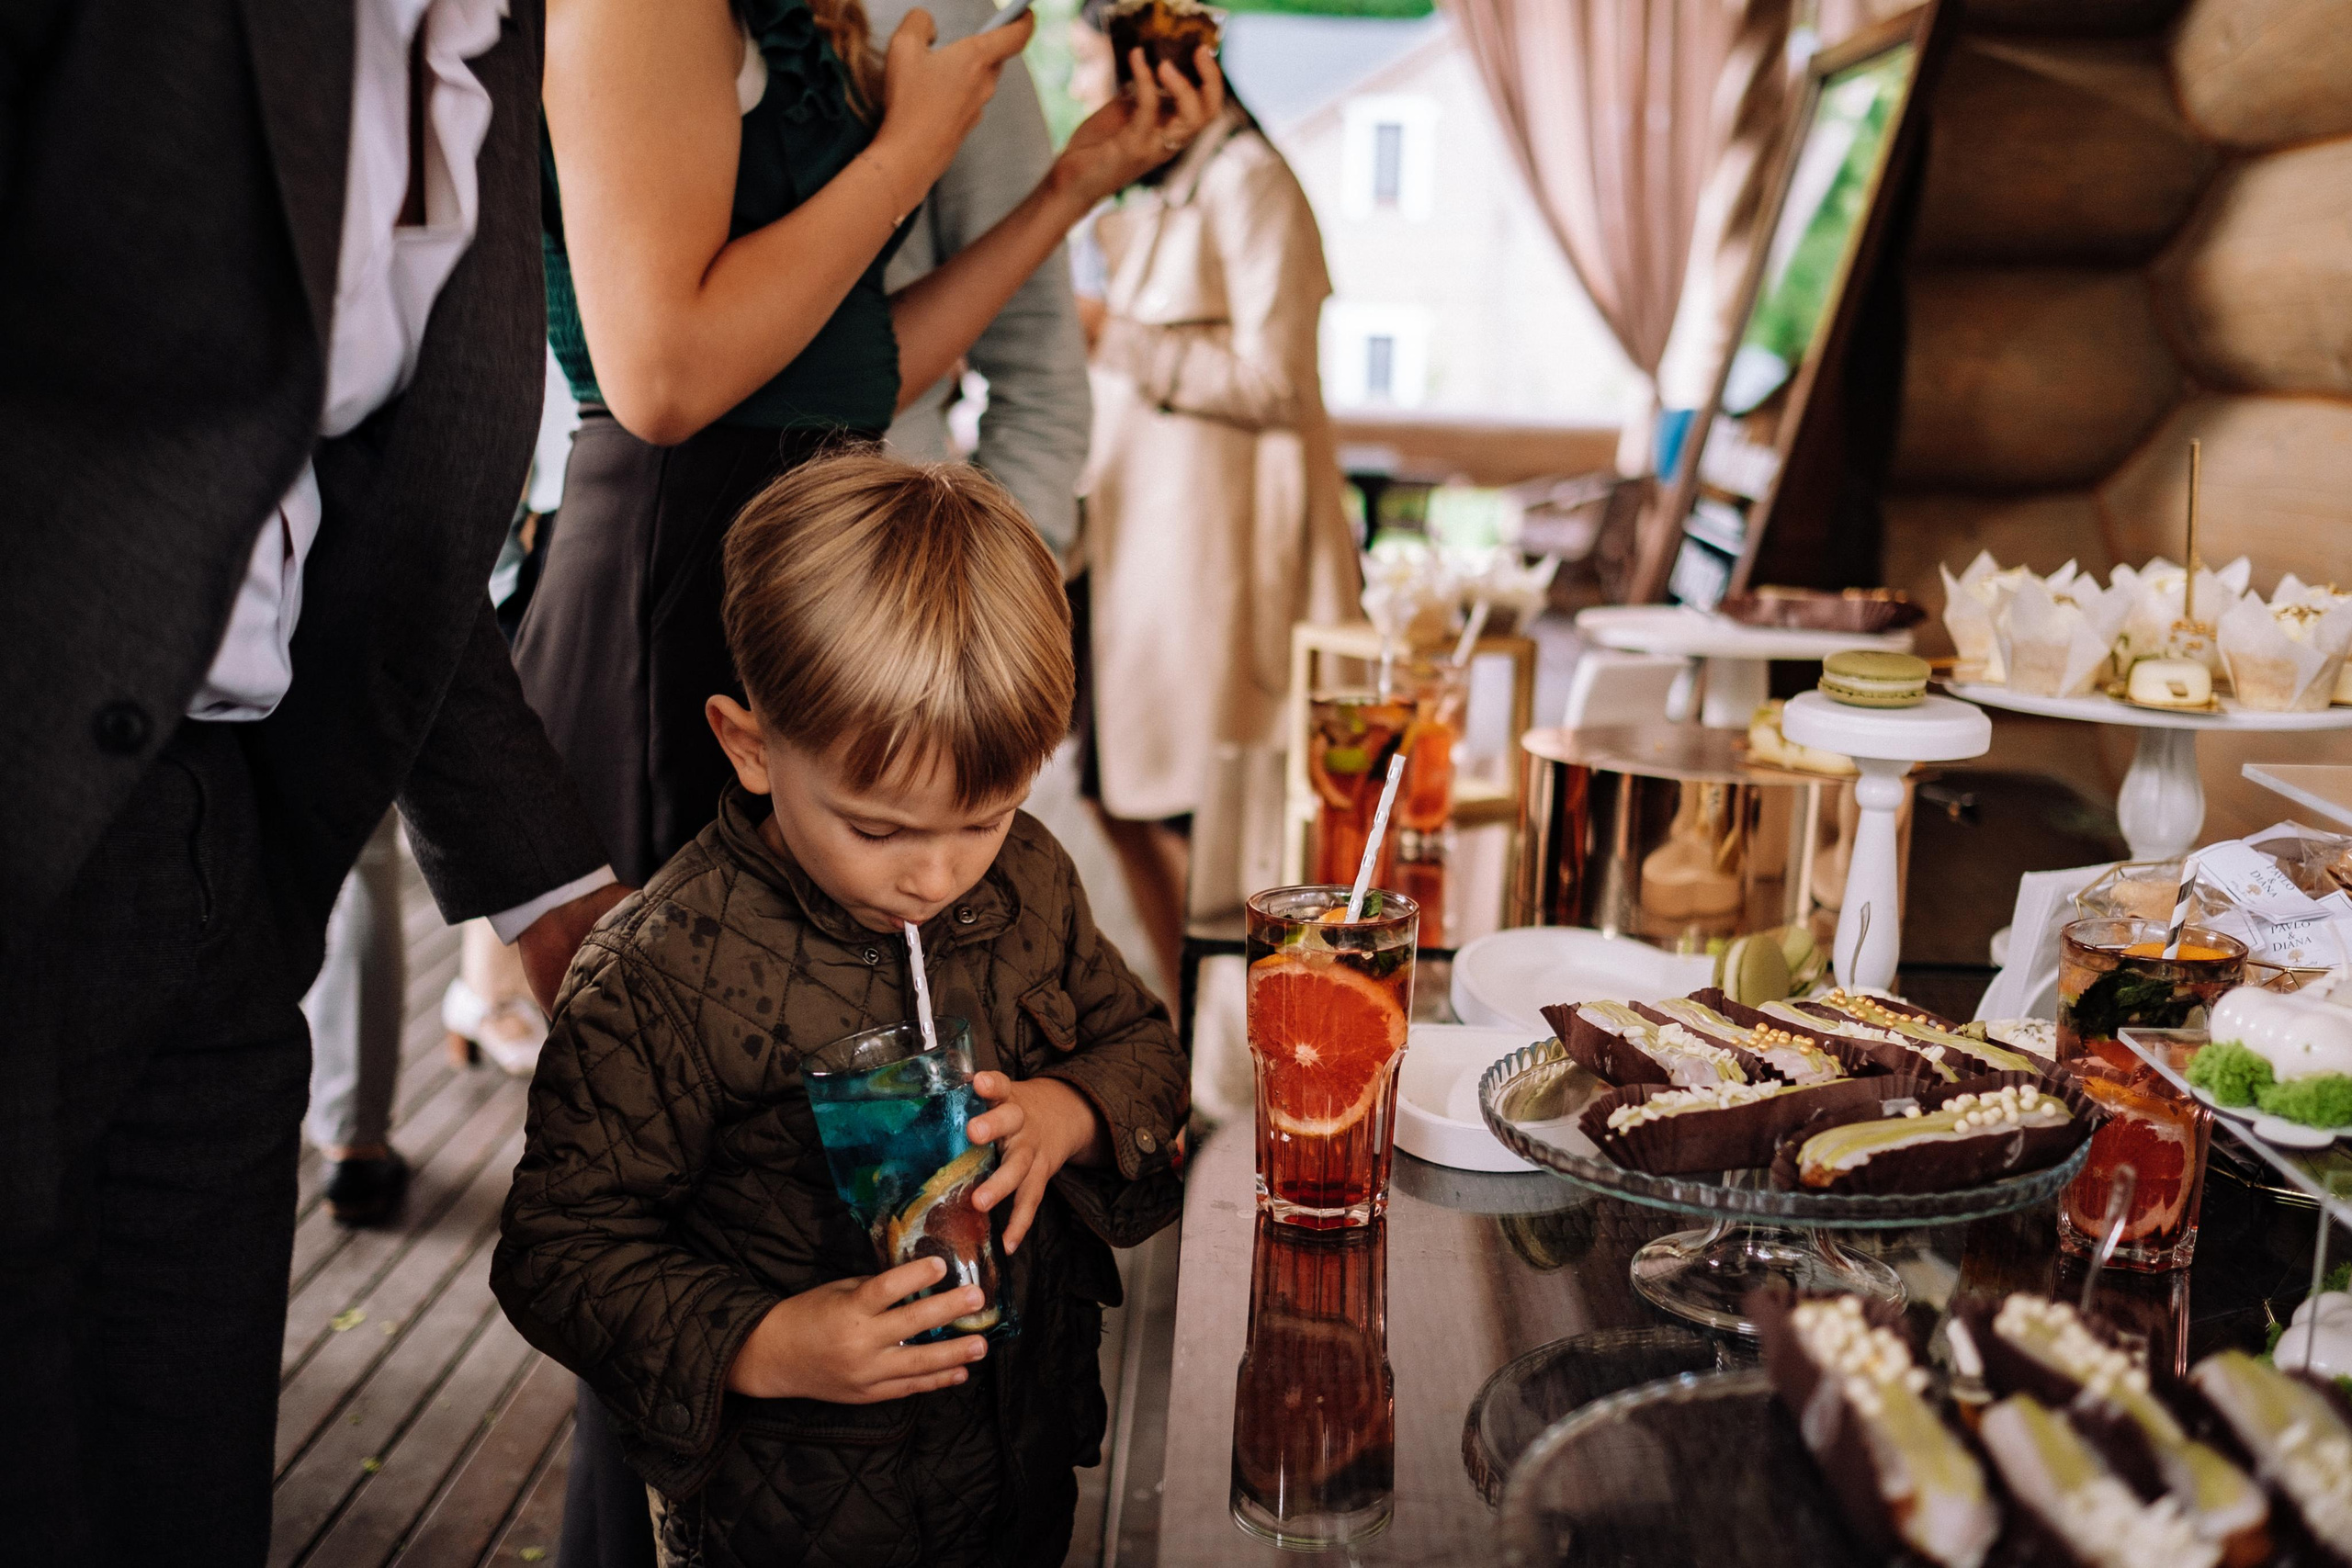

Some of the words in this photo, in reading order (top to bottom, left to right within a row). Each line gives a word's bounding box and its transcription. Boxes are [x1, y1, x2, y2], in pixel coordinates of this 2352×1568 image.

[2250, 870, 2278, 897] DIANA
[2267, 864, 2295, 891] PAVLO
[2270, 921, 2311, 934] PAVLO
[2288, 931, 2295, 940] &
[2273, 936, 2312, 952] DIANA
